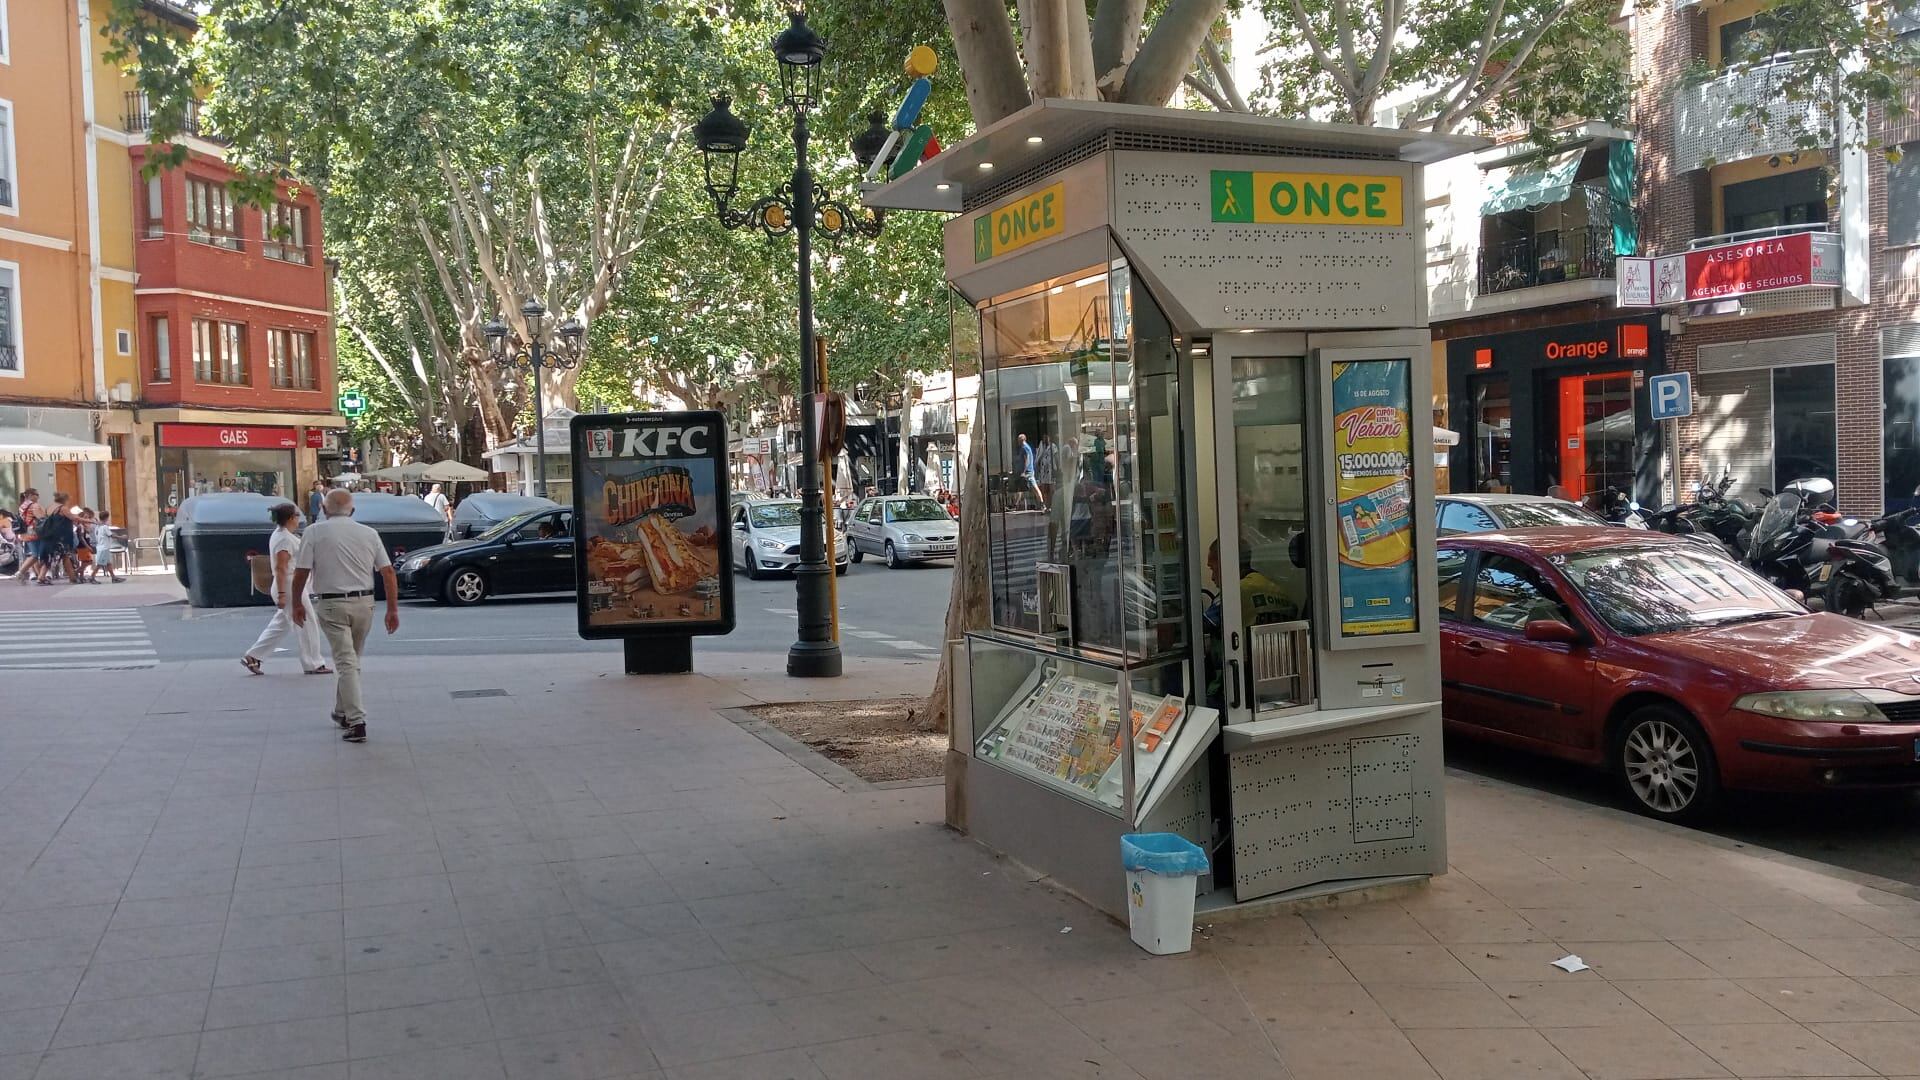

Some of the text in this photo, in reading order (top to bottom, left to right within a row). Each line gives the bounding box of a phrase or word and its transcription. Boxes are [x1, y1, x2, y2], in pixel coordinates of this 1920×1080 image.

[1269, 181, 1387, 218] ONCE
[999, 192, 1055, 245] ONCE
[1691, 284, 1736, 297] AGENCIA
[1739, 281, 1752, 291] DE
[1756, 274, 1803, 288] SEGUROS
[1546, 340, 1608, 359] Orange
[1626, 347, 1646, 356] orange
[1658, 380, 1680, 414] P
[220, 430, 249, 444] GAES
[619, 426, 709, 457] KFC
[1341, 408, 1402, 446] Verano
[13, 452, 44, 461] FORN
[50, 453, 61, 461] DE
[602, 472, 691, 526] CHINGONA
